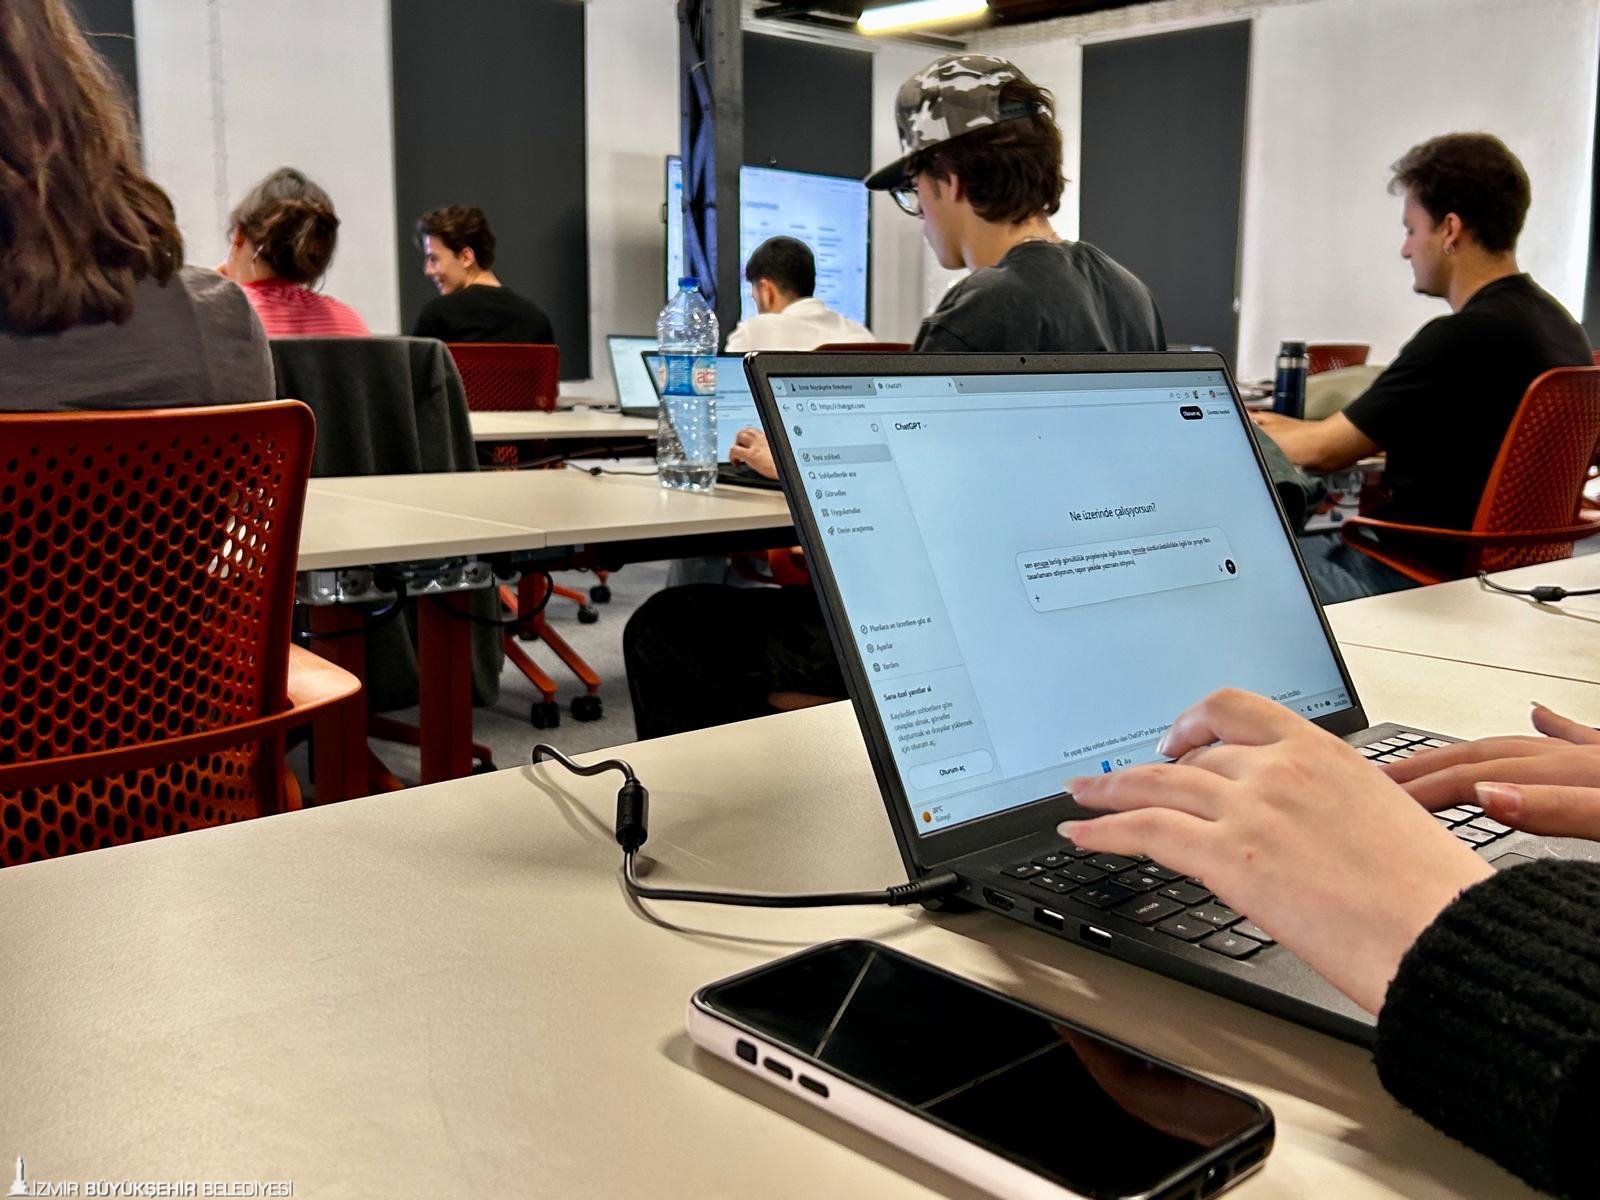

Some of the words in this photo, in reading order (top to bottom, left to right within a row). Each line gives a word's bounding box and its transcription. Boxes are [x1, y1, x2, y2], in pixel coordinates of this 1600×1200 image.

[895, 422, 922, 431] ChatGPT
[1069, 511, 1083, 522] Ne
[1082, 508, 1114, 520] üzerinde
[1114, 502, 1157, 520] çalışıyorsun?
[883, 692, 897, 701] Sana
[938, 766, 960, 776] Oturum
[958, 764, 966, 772] aç
